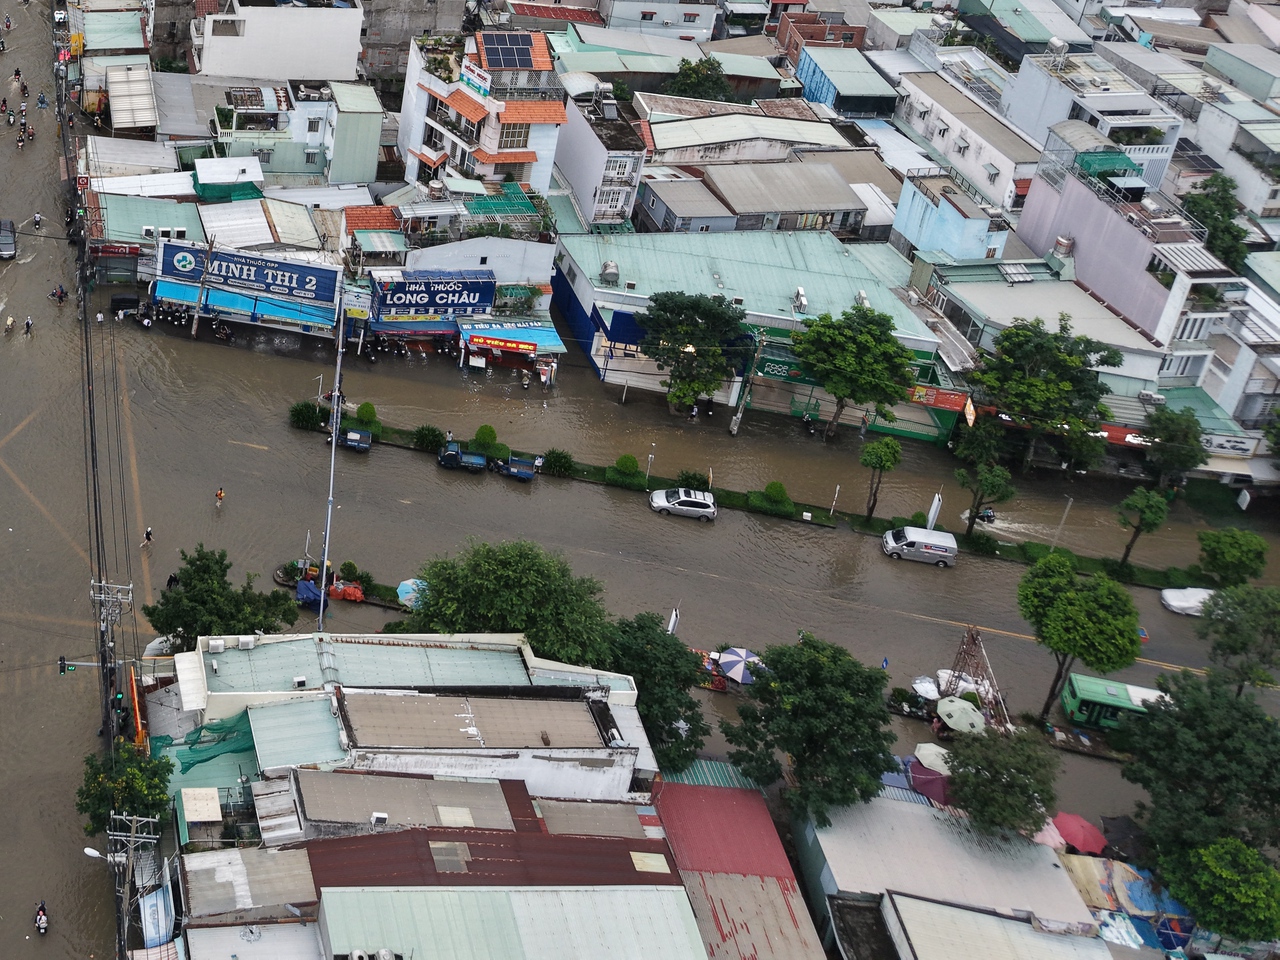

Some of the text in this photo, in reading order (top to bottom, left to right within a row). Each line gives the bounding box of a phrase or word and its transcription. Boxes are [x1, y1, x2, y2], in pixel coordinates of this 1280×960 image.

[247, 258, 266, 267] THUỐC
[204, 258, 317, 290] MINH THI 2
[405, 283, 463, 291] NHÀ THUỐC
[386, 291, 480, 304] LONG CHÂU
